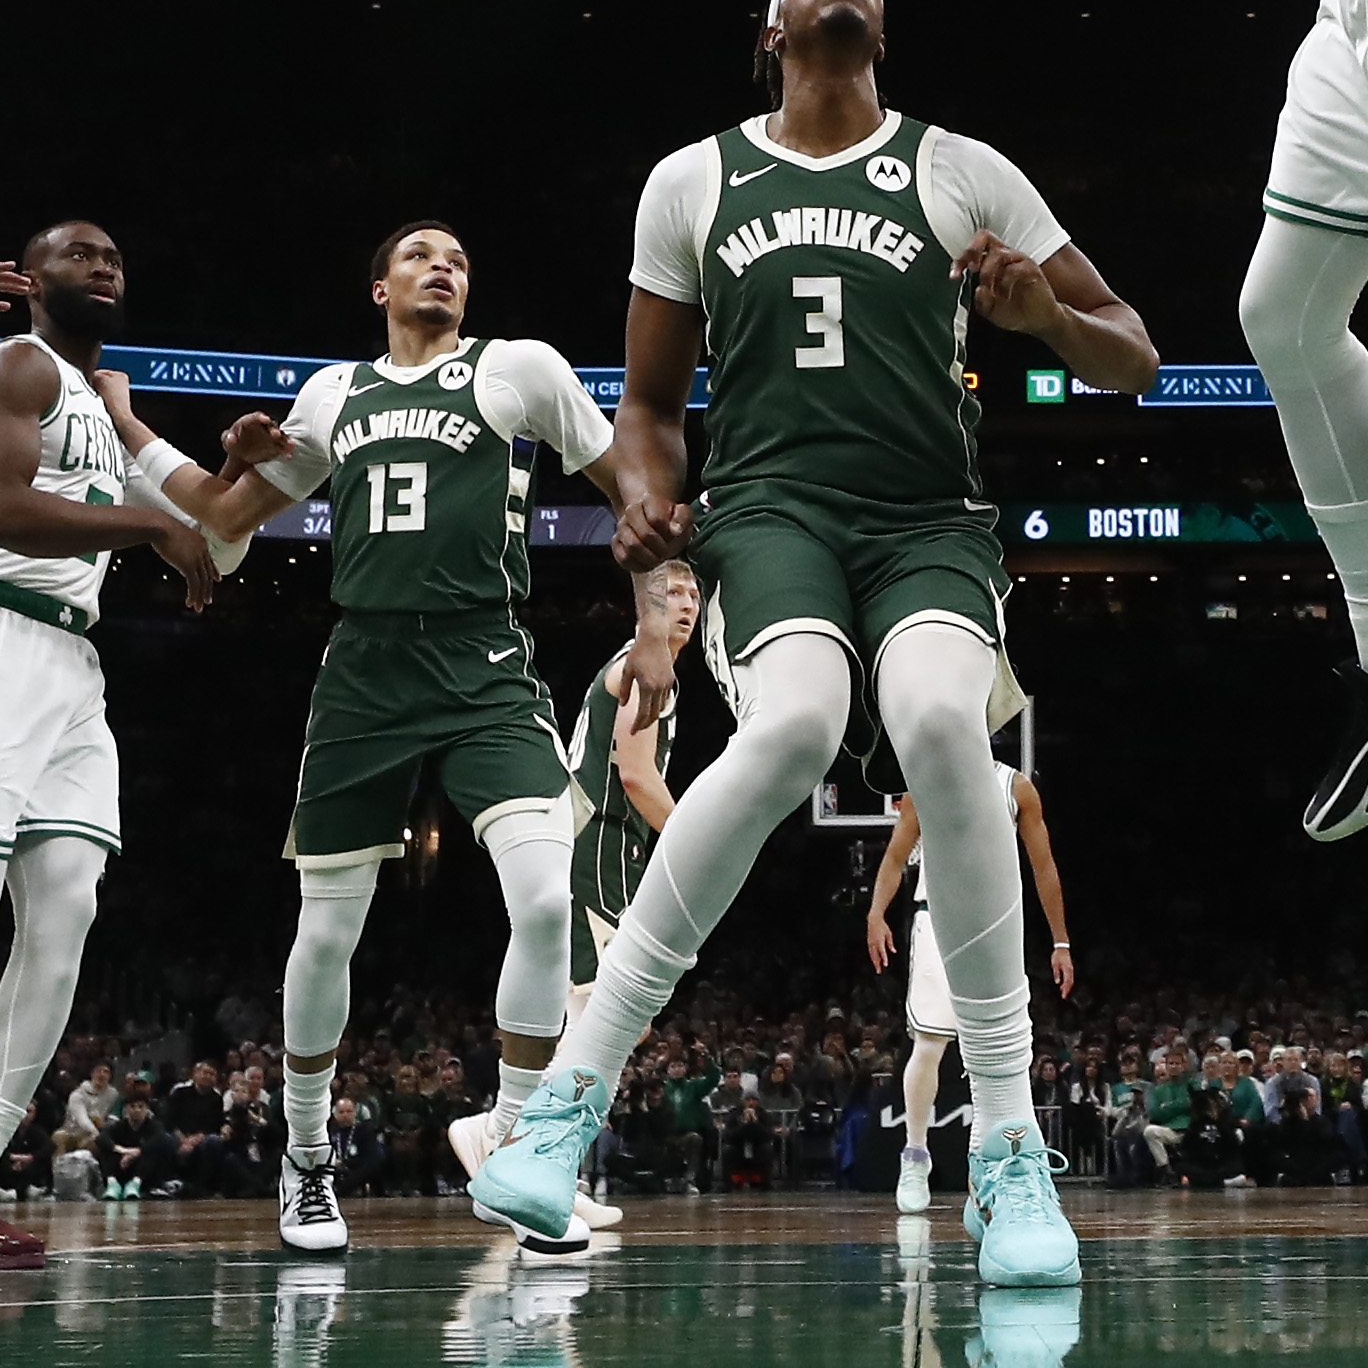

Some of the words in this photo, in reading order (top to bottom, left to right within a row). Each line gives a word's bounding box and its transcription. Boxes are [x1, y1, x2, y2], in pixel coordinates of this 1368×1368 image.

[715, 206, 926, 278] MILWAUKEE
[791, 275, 845, 370] 3
[1029, 374, 1062, 398] TD
[332, 407, 481, 464] MILWAUKEE
[367, 461, 428, 535] 13
[540, 510, 559, 521] FLS
[547, 524, 556, 540] 1
[1024, 509, 1049, 540] 6
[1088, 508, 1180, 538] BOSTON
